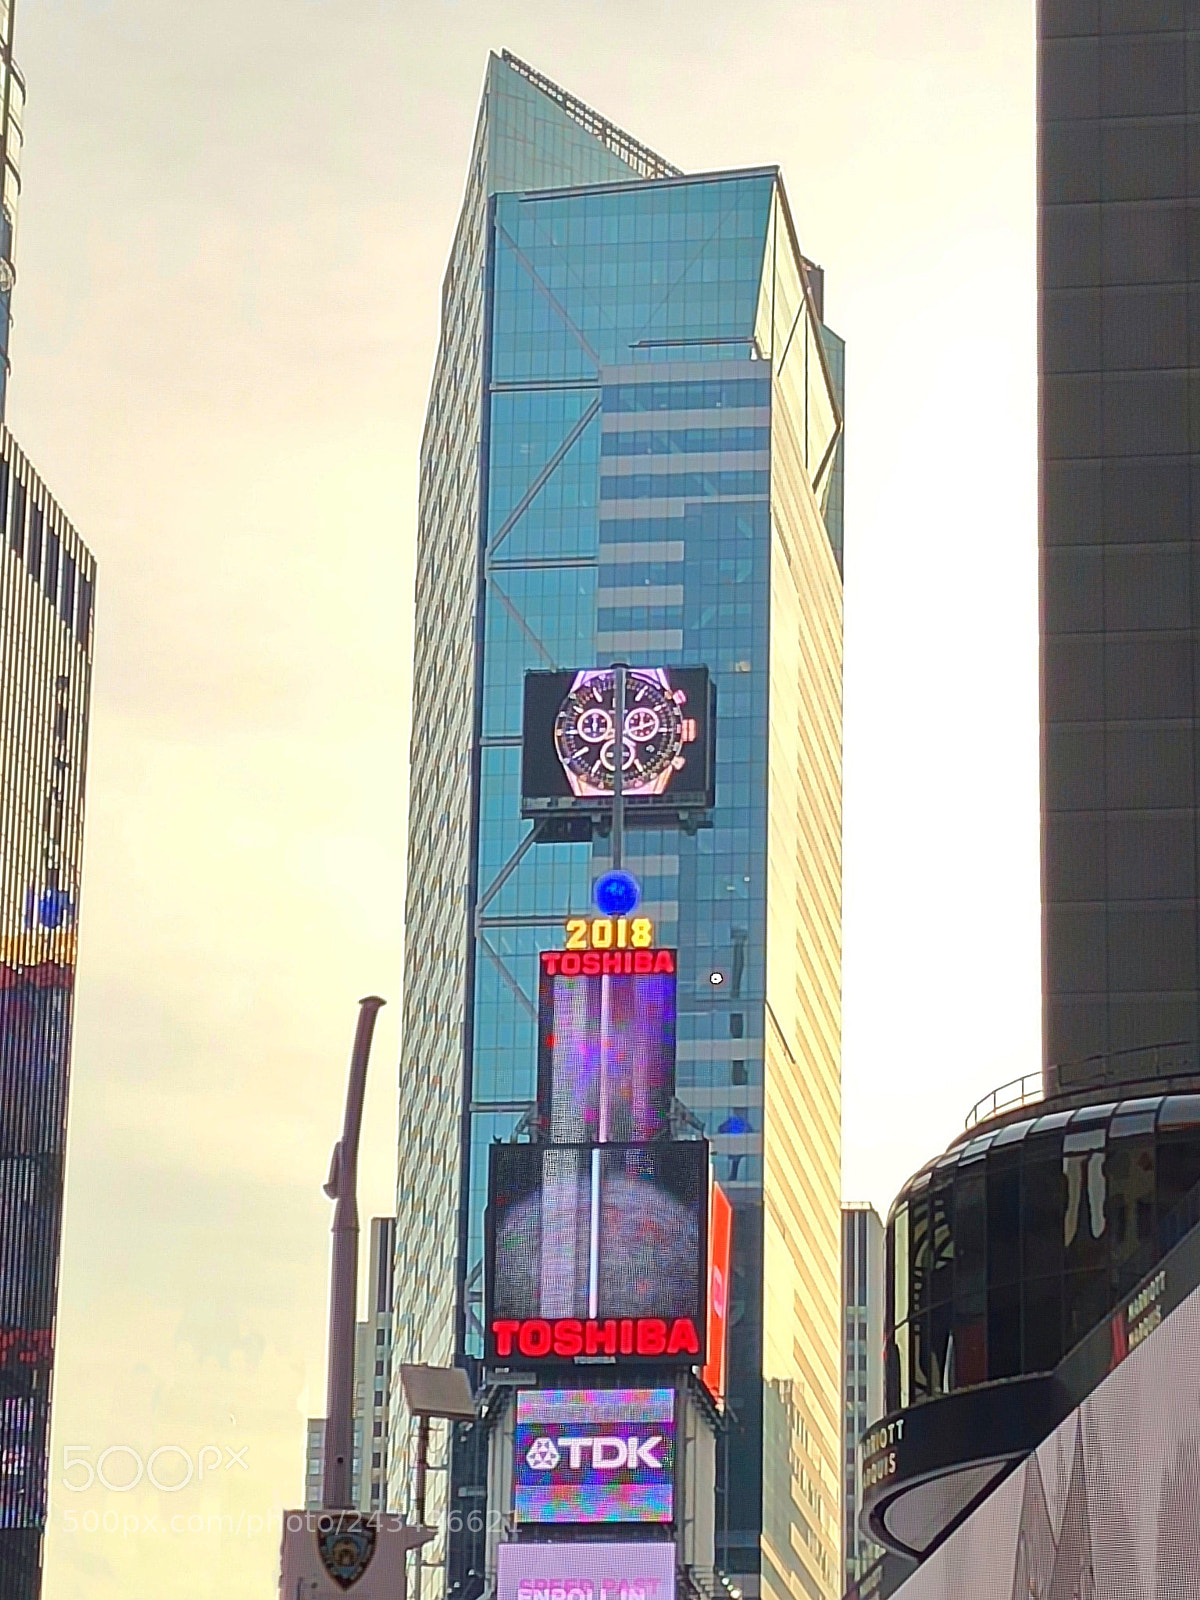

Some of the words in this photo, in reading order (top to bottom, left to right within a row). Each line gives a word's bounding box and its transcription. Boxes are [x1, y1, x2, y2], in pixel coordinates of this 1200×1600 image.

[565, 917, 652, 949] 2018
[541, 951, 675, 976] TOSHIBA
[492, 1319, 699, 1356] TOSHIBA
[558, 1436, 663, 1469] TDK
